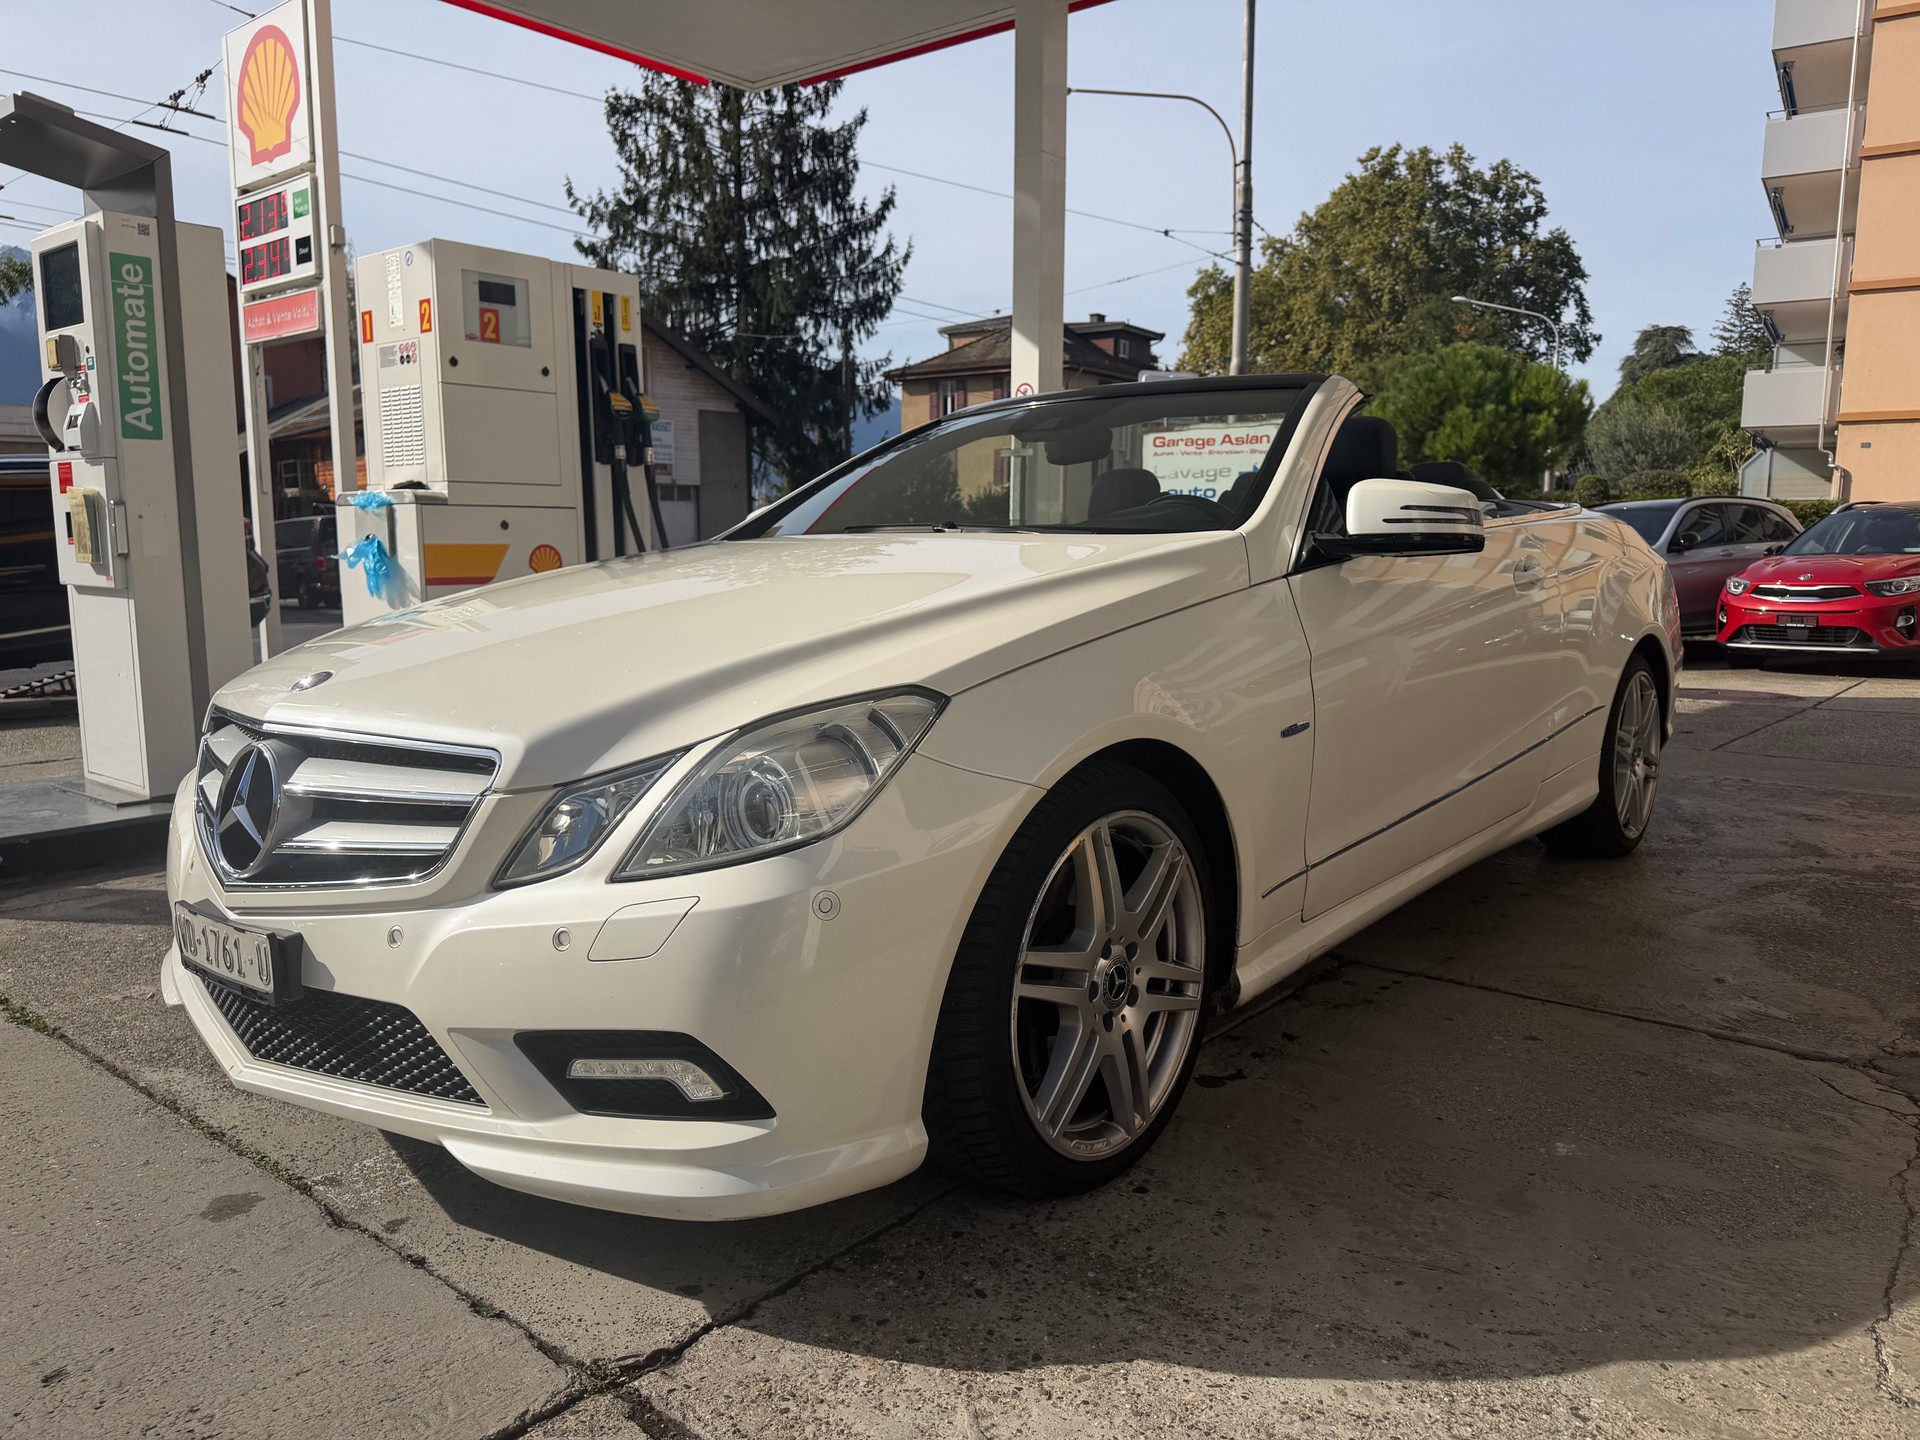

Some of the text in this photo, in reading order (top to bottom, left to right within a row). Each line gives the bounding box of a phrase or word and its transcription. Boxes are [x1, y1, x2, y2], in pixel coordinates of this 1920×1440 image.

[364, 313, 371, 340] 1
[421, 302, 430, 331] 2
[484, 312, 497, 339] 2
[117, 262, 154, 432] Automate
[1152, 433, 1270, 449] Garage Aslan
[1154, 465, 1231, 482] Lavage
